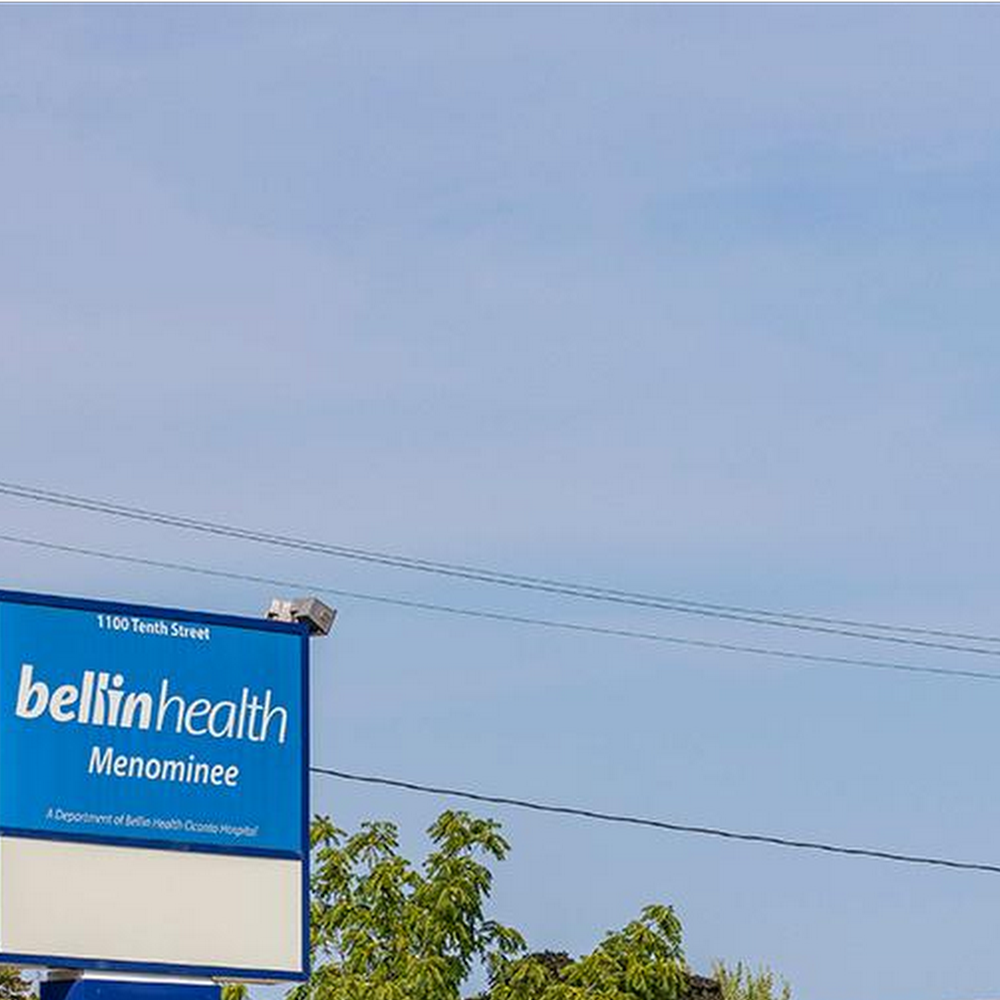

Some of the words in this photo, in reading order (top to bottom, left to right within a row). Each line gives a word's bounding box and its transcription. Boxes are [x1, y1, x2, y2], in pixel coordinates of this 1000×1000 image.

[97, 614, 129, 631] 1100
[131, 618, 168, 635] Tenth
[170, 622, 210, 640] Street
[88, 746, 239, 786] Menominee
[55, 808, 111, 824] Department
[113, 812, 125, 825] of
[150, 815, 183, 830] Health
